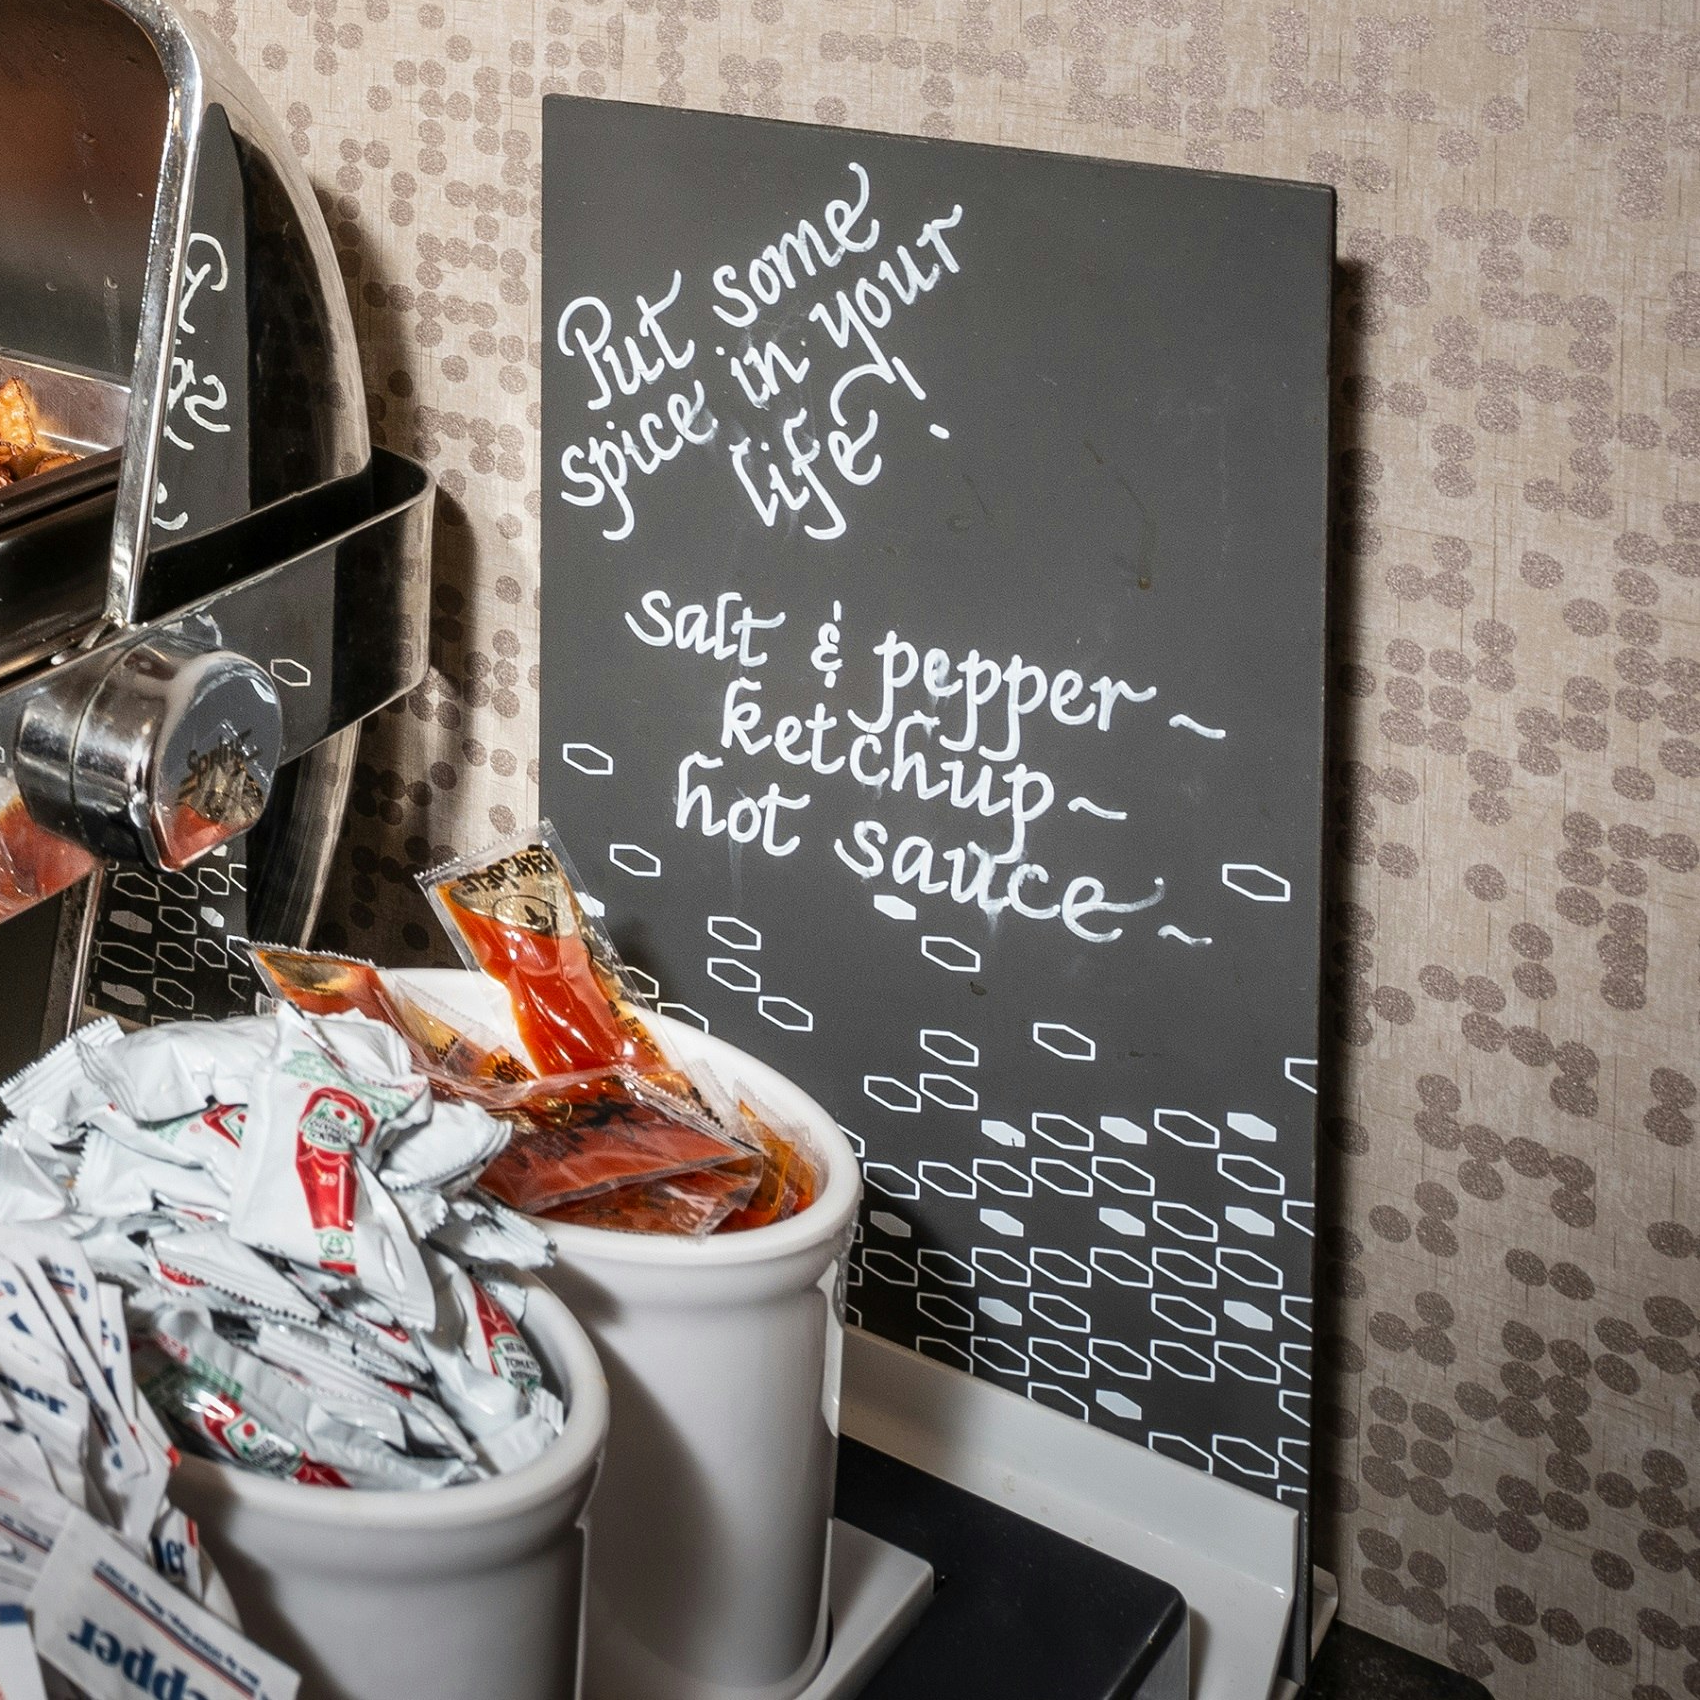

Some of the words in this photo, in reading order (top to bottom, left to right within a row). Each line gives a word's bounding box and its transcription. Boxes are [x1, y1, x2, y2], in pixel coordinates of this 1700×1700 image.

[557, 269, 694, 410] Put
[712, 162, 881, 329] some
[559, 379, 720, 542] spice
[714, 338, 810, 409] in
[808, 204, 965, 427] your
[719, 679, 1057, 864] ketchup
[848, 628, 1157, 763] pepper
[672, 750, 810, 857] hot
[833, 819, 1166, 945] sauce
[504, 1355, 540, 1373] TOMAT
